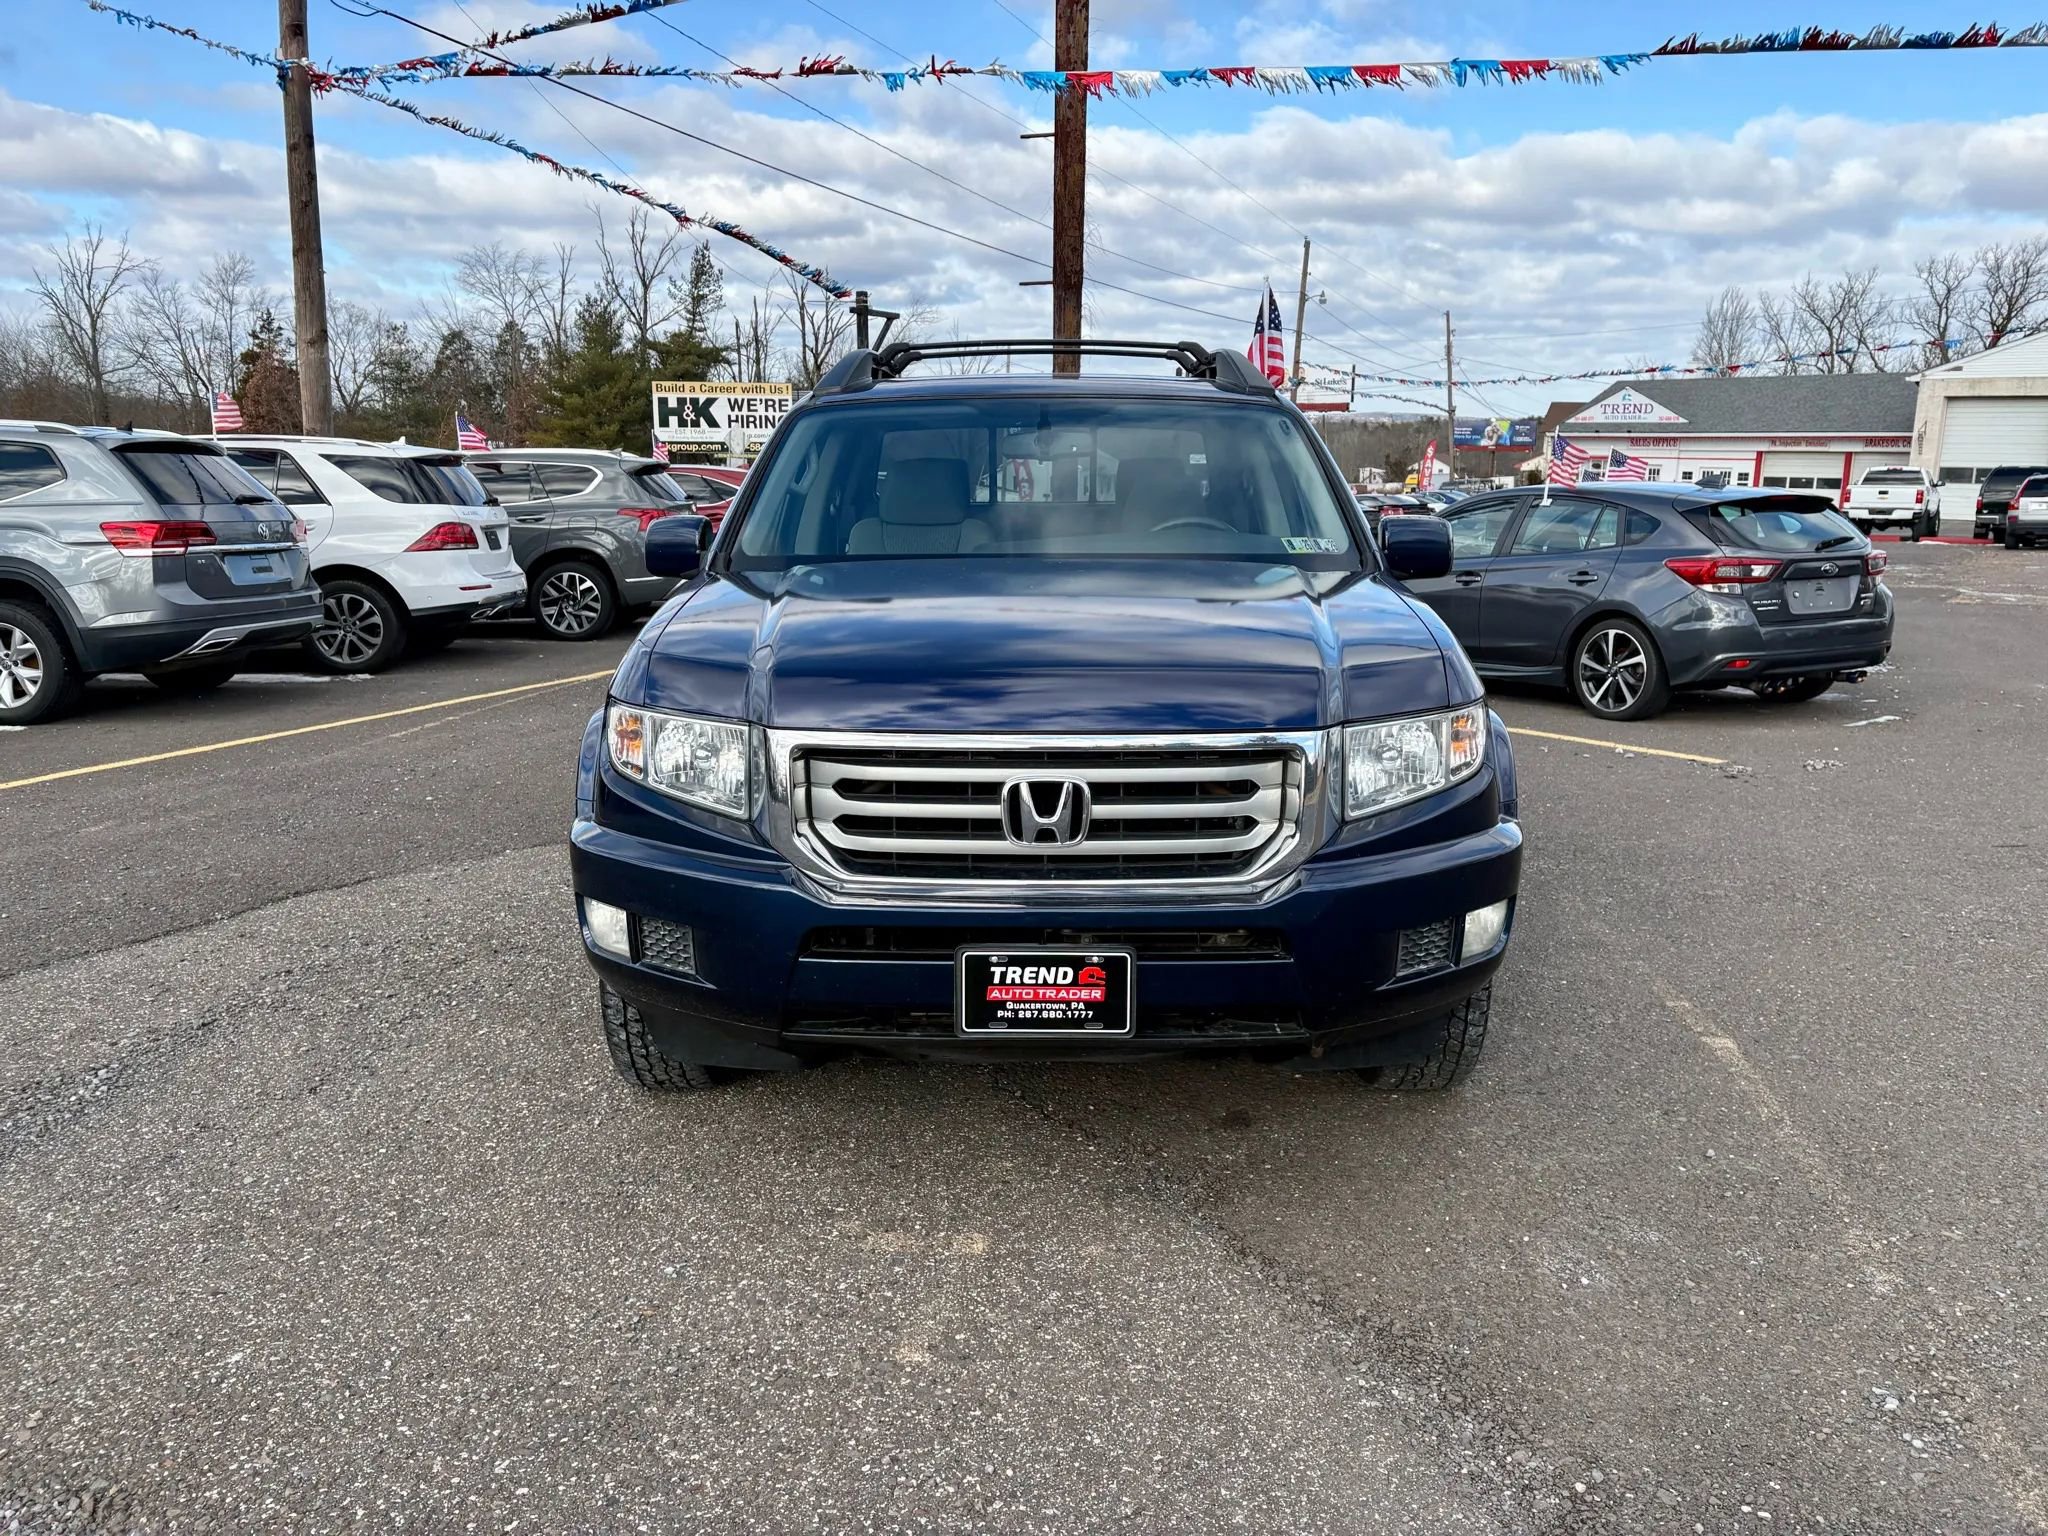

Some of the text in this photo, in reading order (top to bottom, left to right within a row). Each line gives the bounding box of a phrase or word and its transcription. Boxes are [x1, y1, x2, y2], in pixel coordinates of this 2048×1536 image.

[655, 383, 685, 393] Build
[700, 384, 737, 394] Career
[742, 385, 766, 394] with
[727, 398, 789, 412] WE'RE
[1600, 403, 1654, 414] TREND
[657, 397, 721, 428] H&K
[660, 442, 722, 452] kgroup.com
[1630, 437, 1679, 448] SALES OFFICE
[1864, 438, 1890, 448] BRAKES
[1890, 438, 1900, 448] OIL
[990, 966, 1074, 985] TREND
[989, 989, 1102, 999] AUTO TRADER
[1071, 1002, 1085, 1010] PA
[997, 1010, 1015, 1018] PH:
